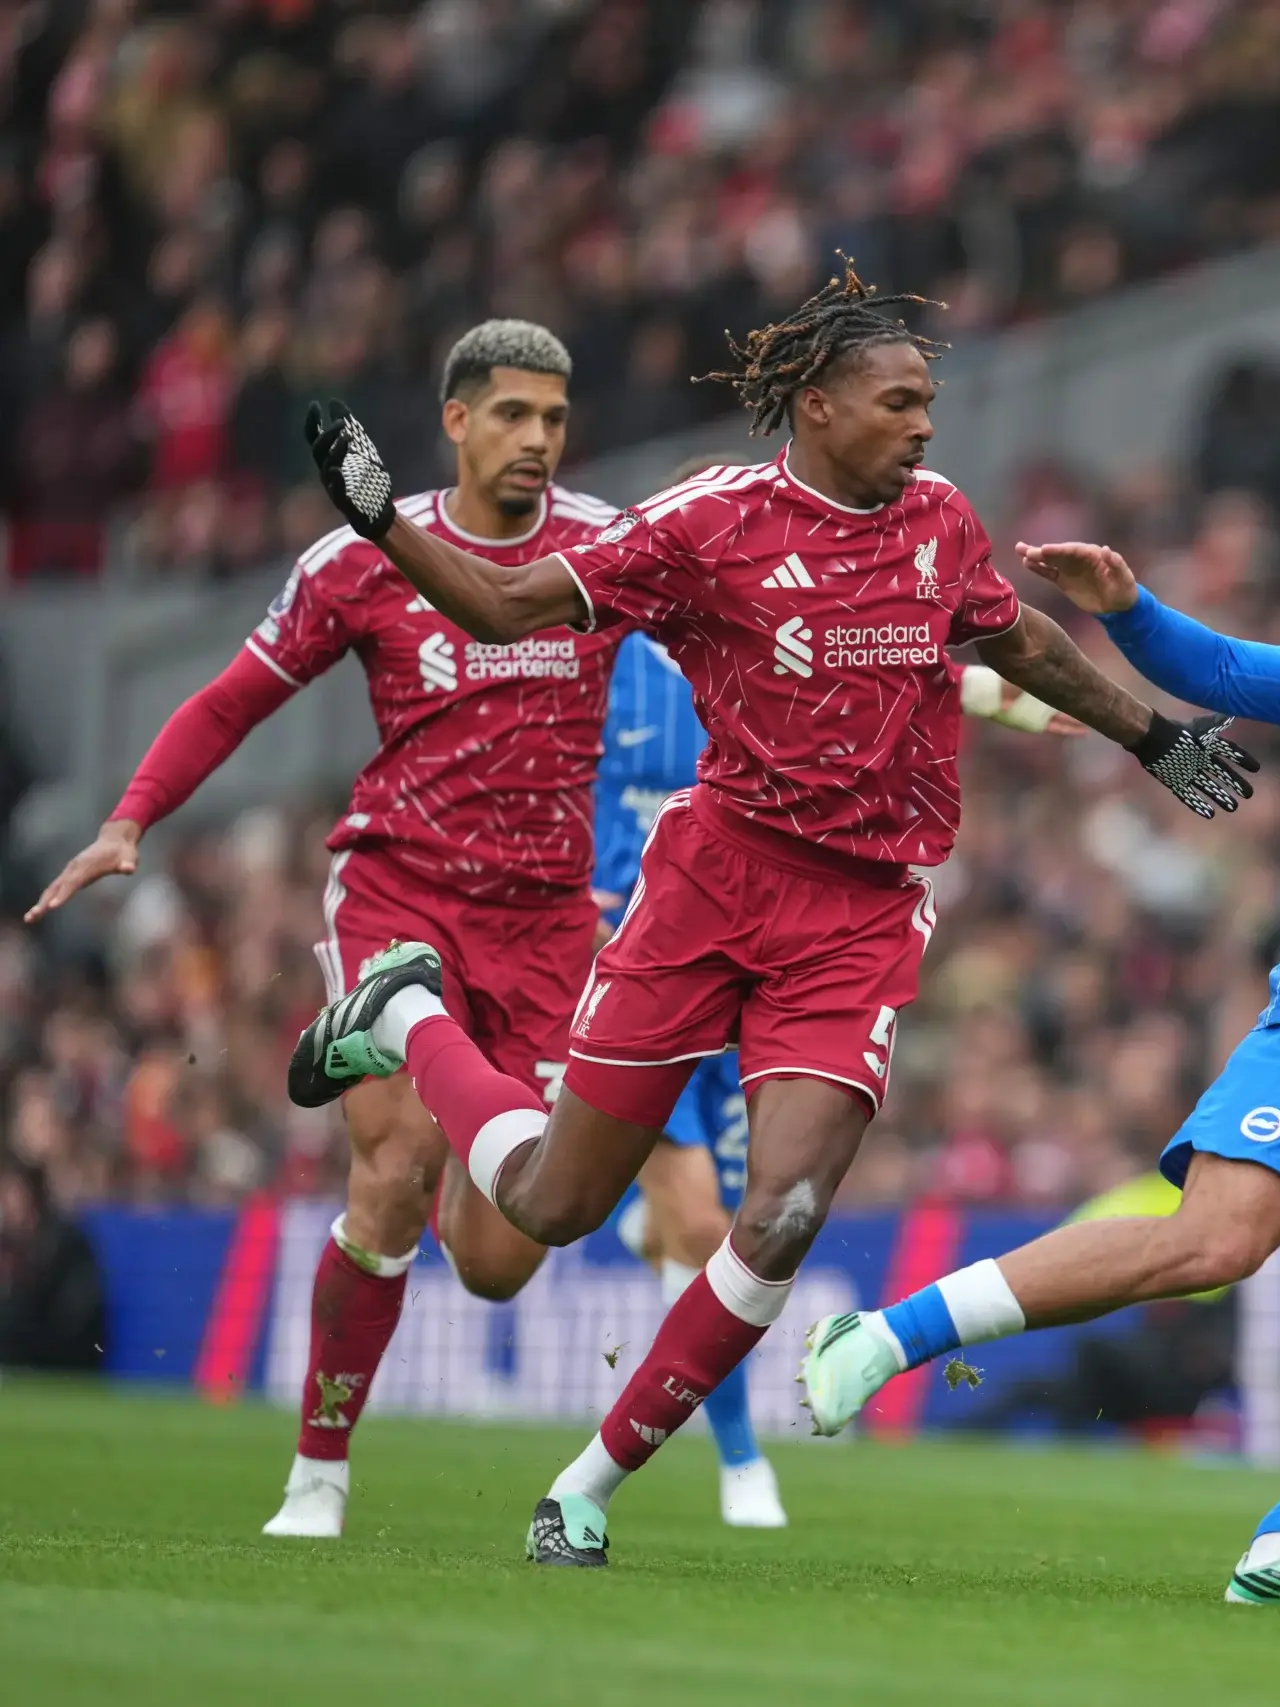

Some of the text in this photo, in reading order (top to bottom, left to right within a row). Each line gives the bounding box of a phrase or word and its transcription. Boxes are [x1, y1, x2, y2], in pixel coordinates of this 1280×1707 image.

[824, 622, 931, 646] standard
[464, 638, 576, 660] standard
[823, 643, 938, 668] chartered
[465, 656, 580, 680] chartered
[863, 1005, 896, 1078] 5
